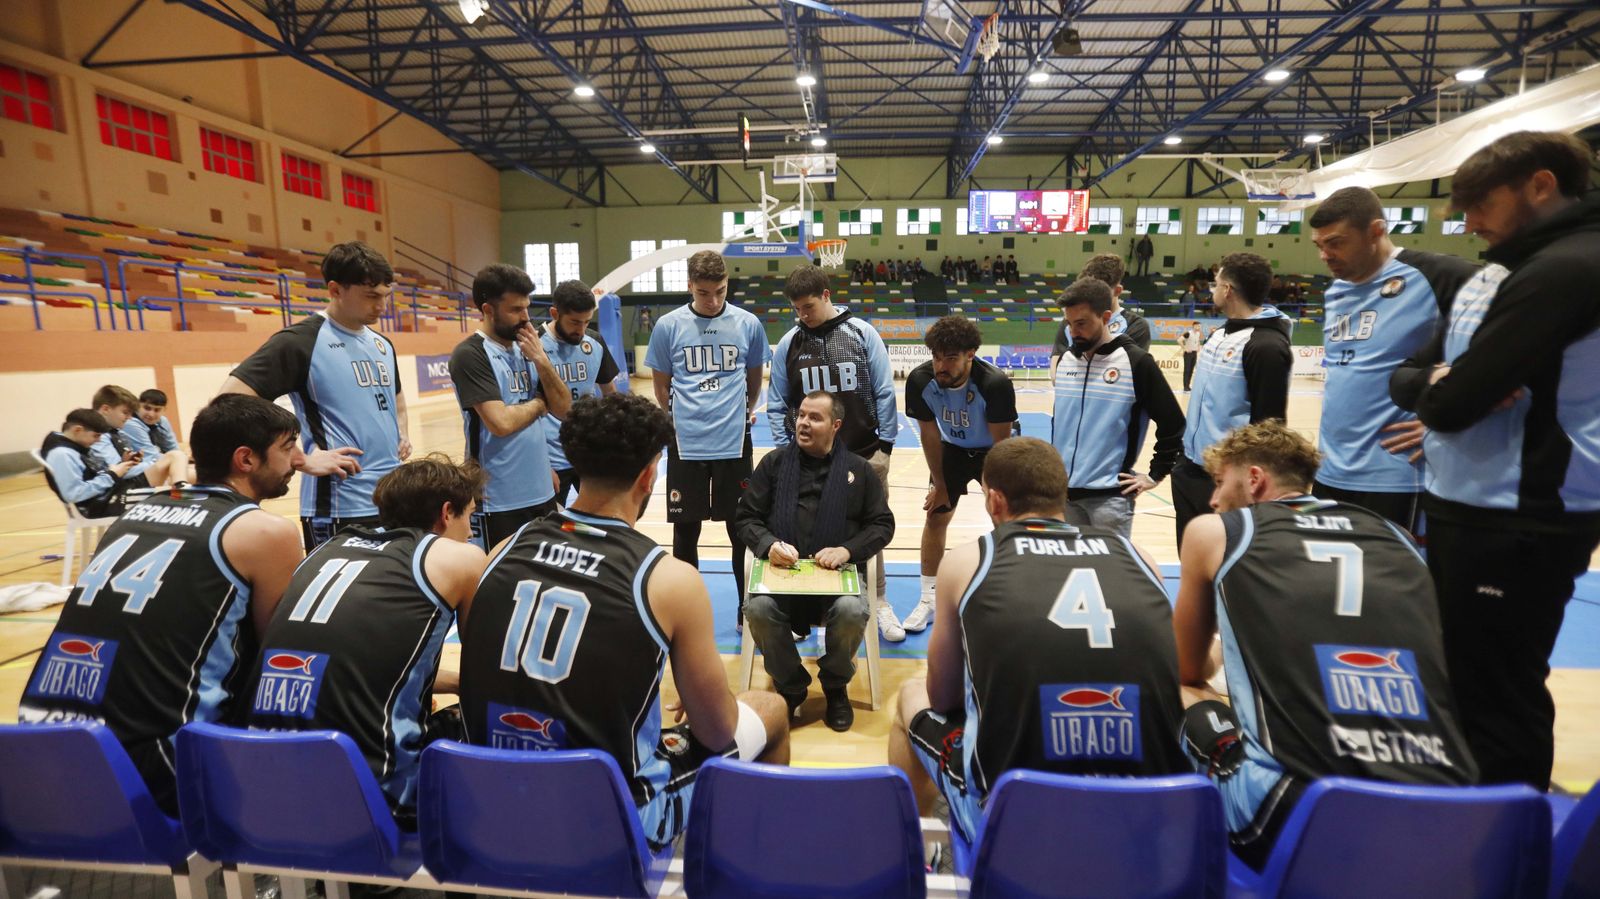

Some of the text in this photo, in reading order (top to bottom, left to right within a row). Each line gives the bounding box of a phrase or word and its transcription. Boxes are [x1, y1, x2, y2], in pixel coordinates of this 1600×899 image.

[683, 345, 740, 373] ULB
[890, 346, 932, 356] UBAGO GROU
[351, 360, 391, 388] ULB
[555, 361, 588, 383] ULB
[700, 378, 720, 392] 33
[800, 361, 858, 396] ULB
[374, 393, 388, 411] 12
[123, 504, 209, 528] ESPADIÑA
[1294, 514, 1353, 531] SLIM
[533, 541, 606, 578] LÓPEZ
[1015, 534, 1110, 556] FURLÁN
[76, 533, 186, 615] 44
[288, 558, 370, 624] 11
[1302, 540, 1364, 616] 7
[1048, 568, 1116, 649] 4
[500, 579, 592, 685] 10
[39, 660, 102, 700] UBAGO
[255, 677, 313, 714] UBAGO
[1329, 672, 1421, 717] UBAGO
[1051, 717, 1134, 757] UBAGO
